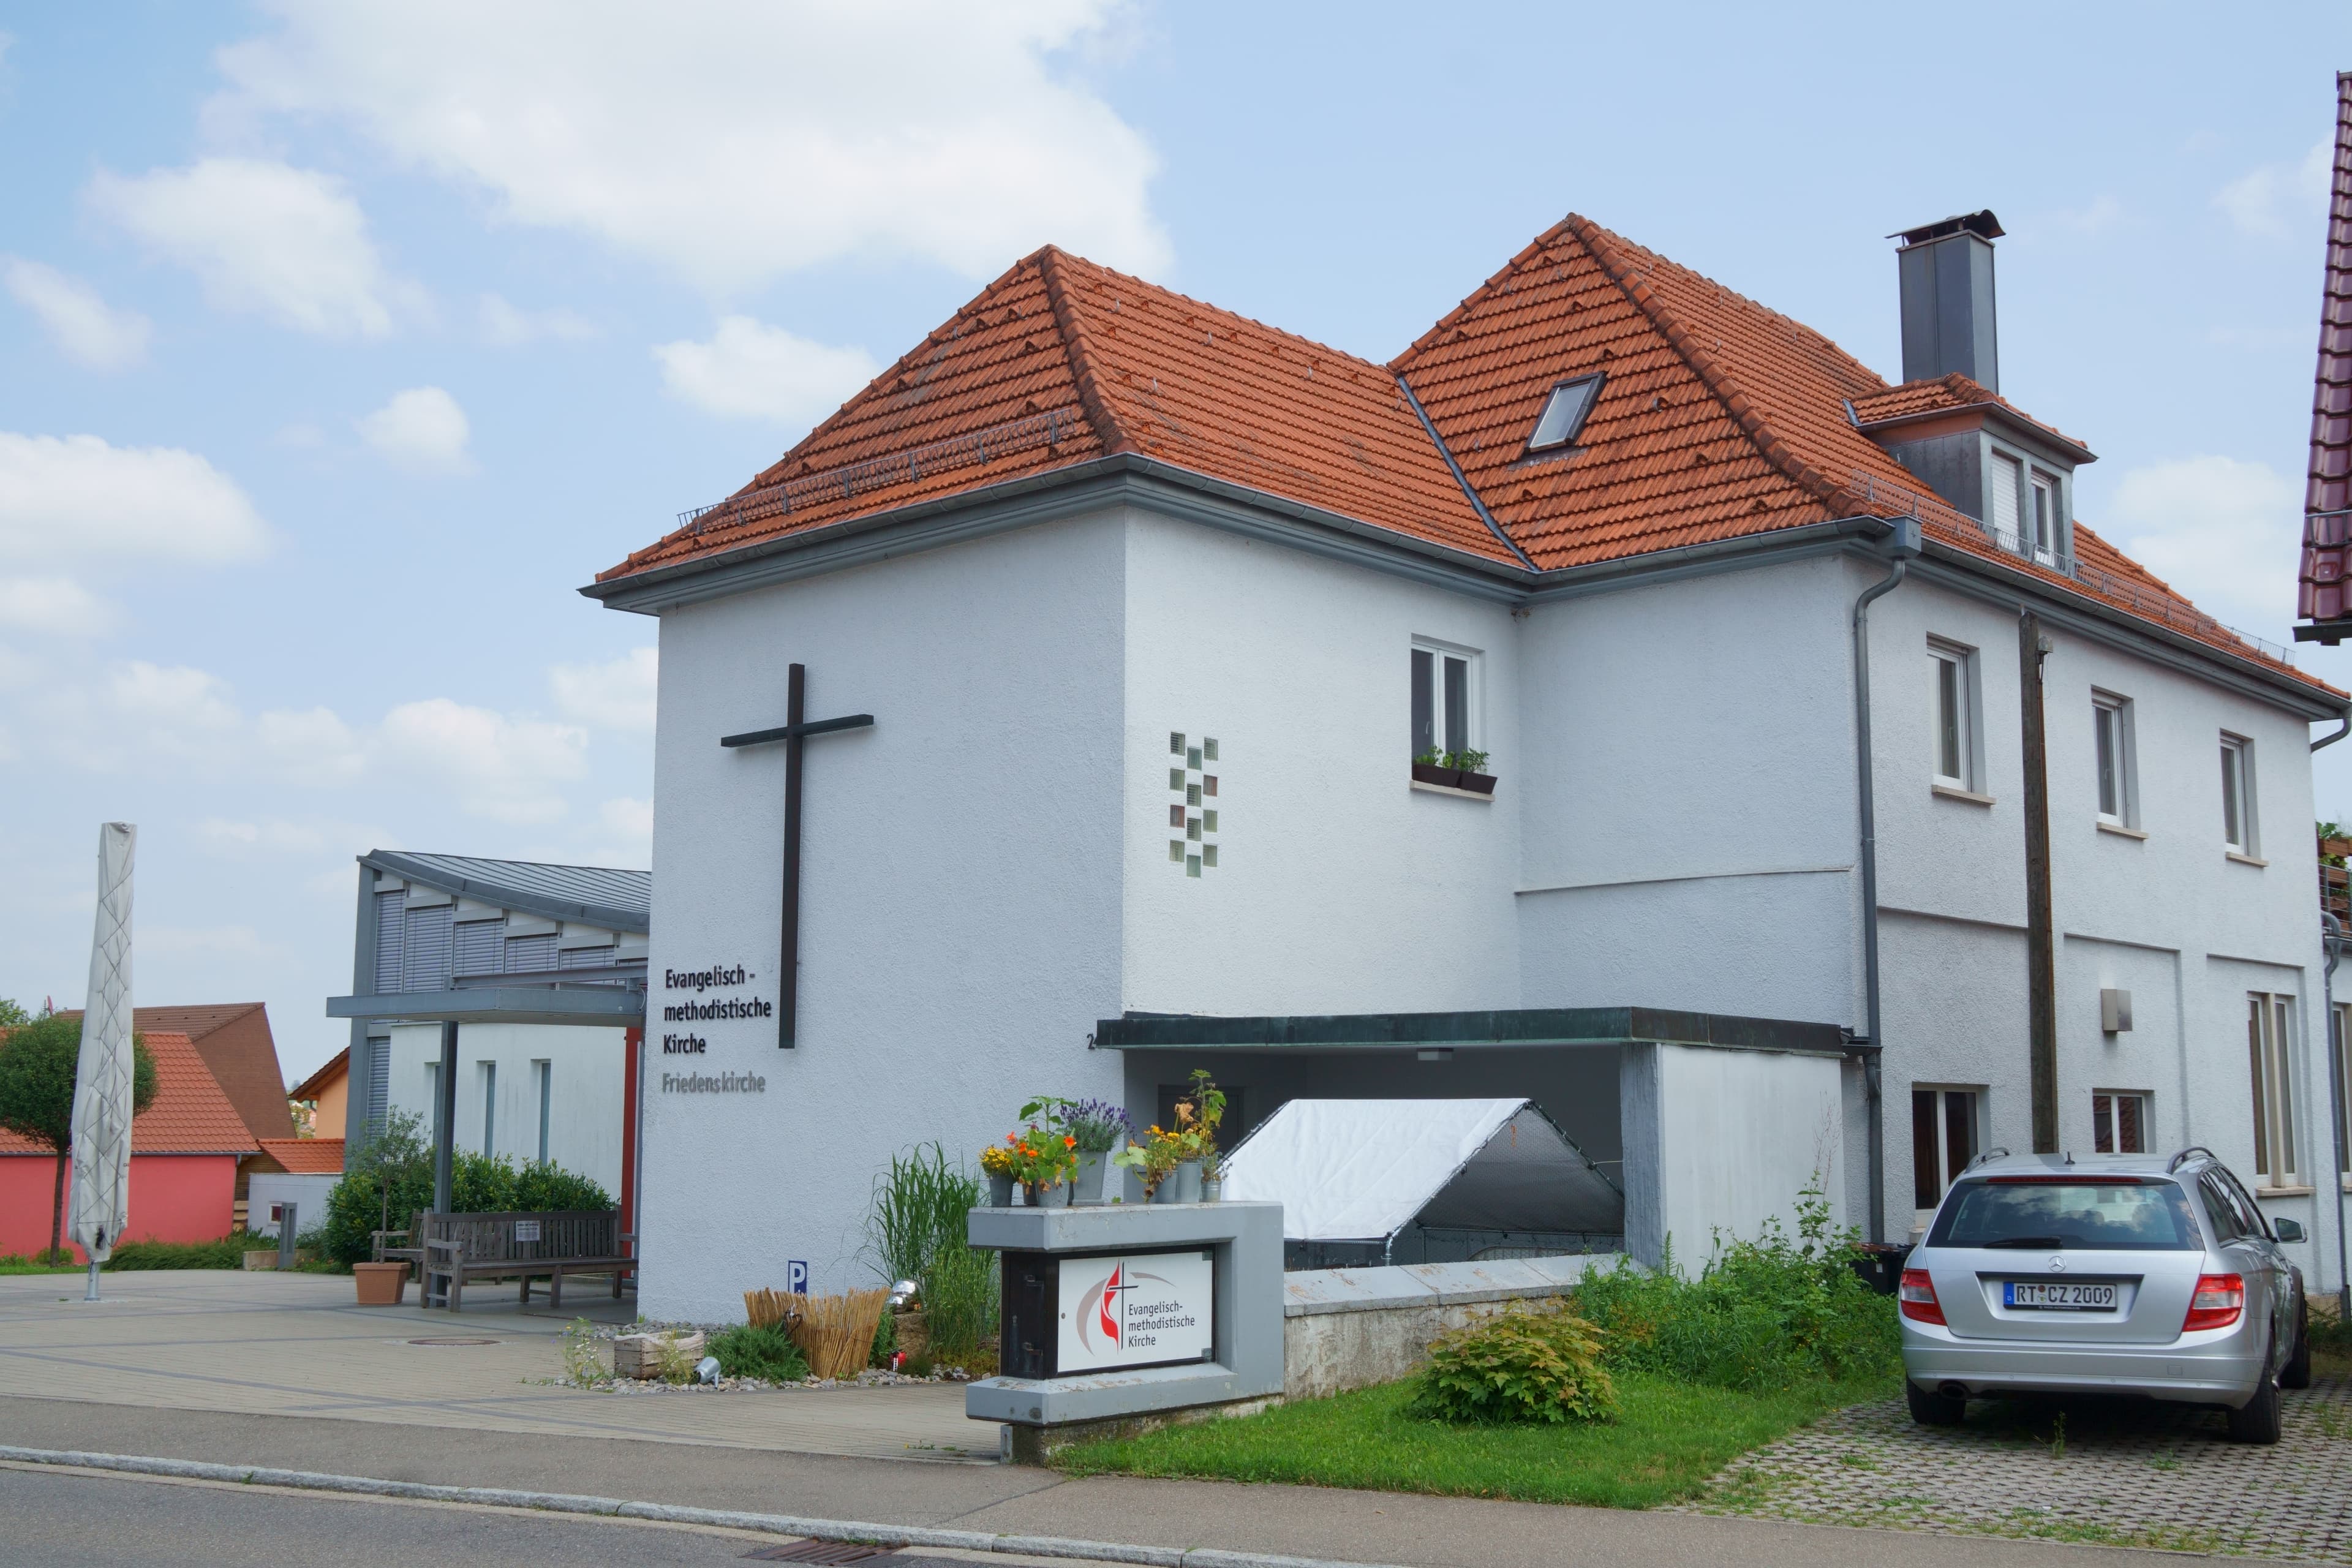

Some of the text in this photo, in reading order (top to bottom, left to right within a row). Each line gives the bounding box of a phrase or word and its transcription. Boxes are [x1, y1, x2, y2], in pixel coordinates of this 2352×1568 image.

[665, 963, 745, 992] Evangelisch
[664, 996, 772, 1022] methodistische
[663, 1033, 706, 1054] Kirche
[662, 1070, 766, 1093] Friedenskirche
[789, 1262, 806, 1294] P
[2016, 1286, 2113, 1304] RT CZ 2009
[1128, 1300, 1183, 1317] Evangelisch-
[1128, 1314, 1196, 1332] methodistische
[1128, 1334, 1156, 1348] Kirche
